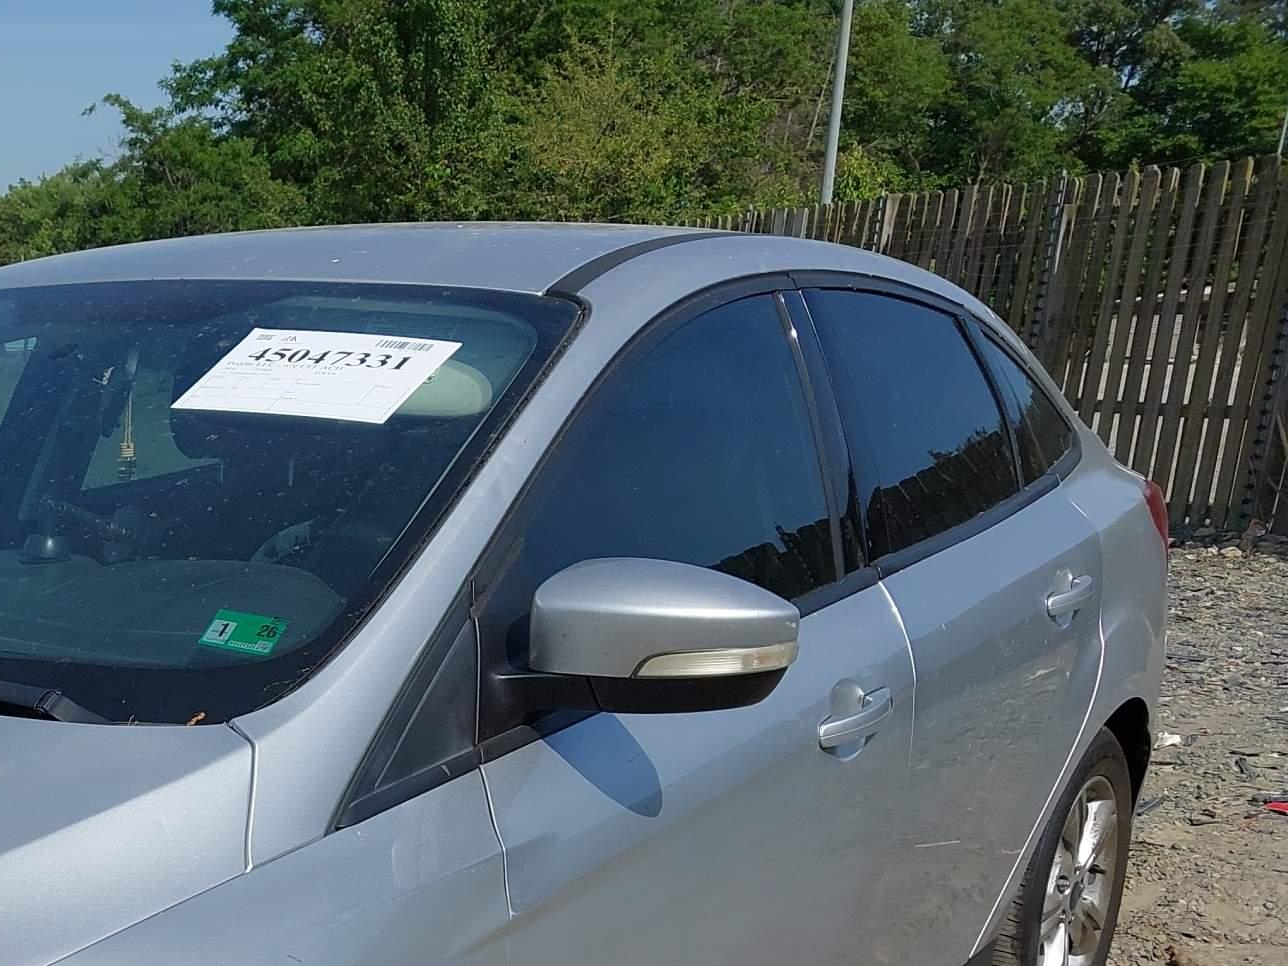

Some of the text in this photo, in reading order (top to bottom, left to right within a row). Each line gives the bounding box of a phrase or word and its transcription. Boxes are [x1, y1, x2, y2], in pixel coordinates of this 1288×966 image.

[247, 347, 413, 371] 45047331
[219, 622, 230, 638] 1
[255, 624, 279, 639] 26
